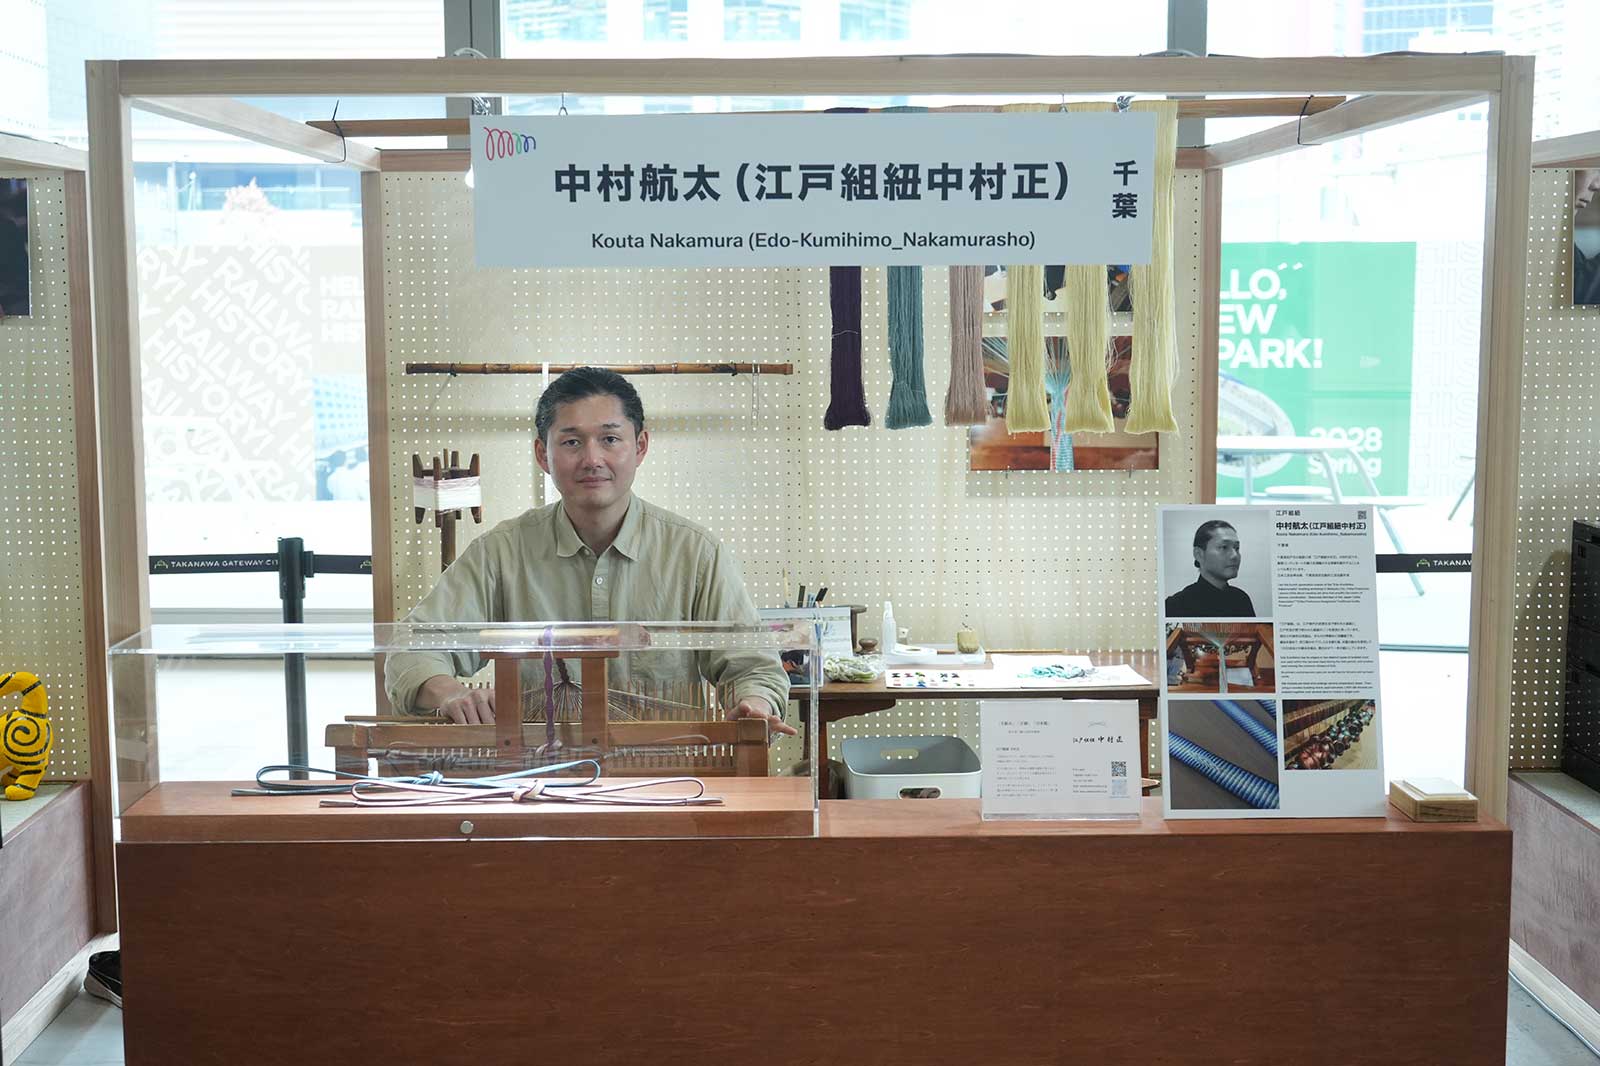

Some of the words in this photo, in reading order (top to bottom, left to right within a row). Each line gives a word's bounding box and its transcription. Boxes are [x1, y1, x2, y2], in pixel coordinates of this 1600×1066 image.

[554, 161, 1068, 203] 中村航太（江戸組紐中村正）
[1111, 159, 1139, 219] 千葉
[591, 233, 645, 249] Kouta
[650, 232, 743, 248] Nakamura
[748, 231, 1035, 252] (Edo-Kumihimo_Nakamurasho)
[1219, 268, 1287, 301] LO,
[171, 560, 220, 568] TAKANAWA
[222, 559, 264, 567] GATEWAY
